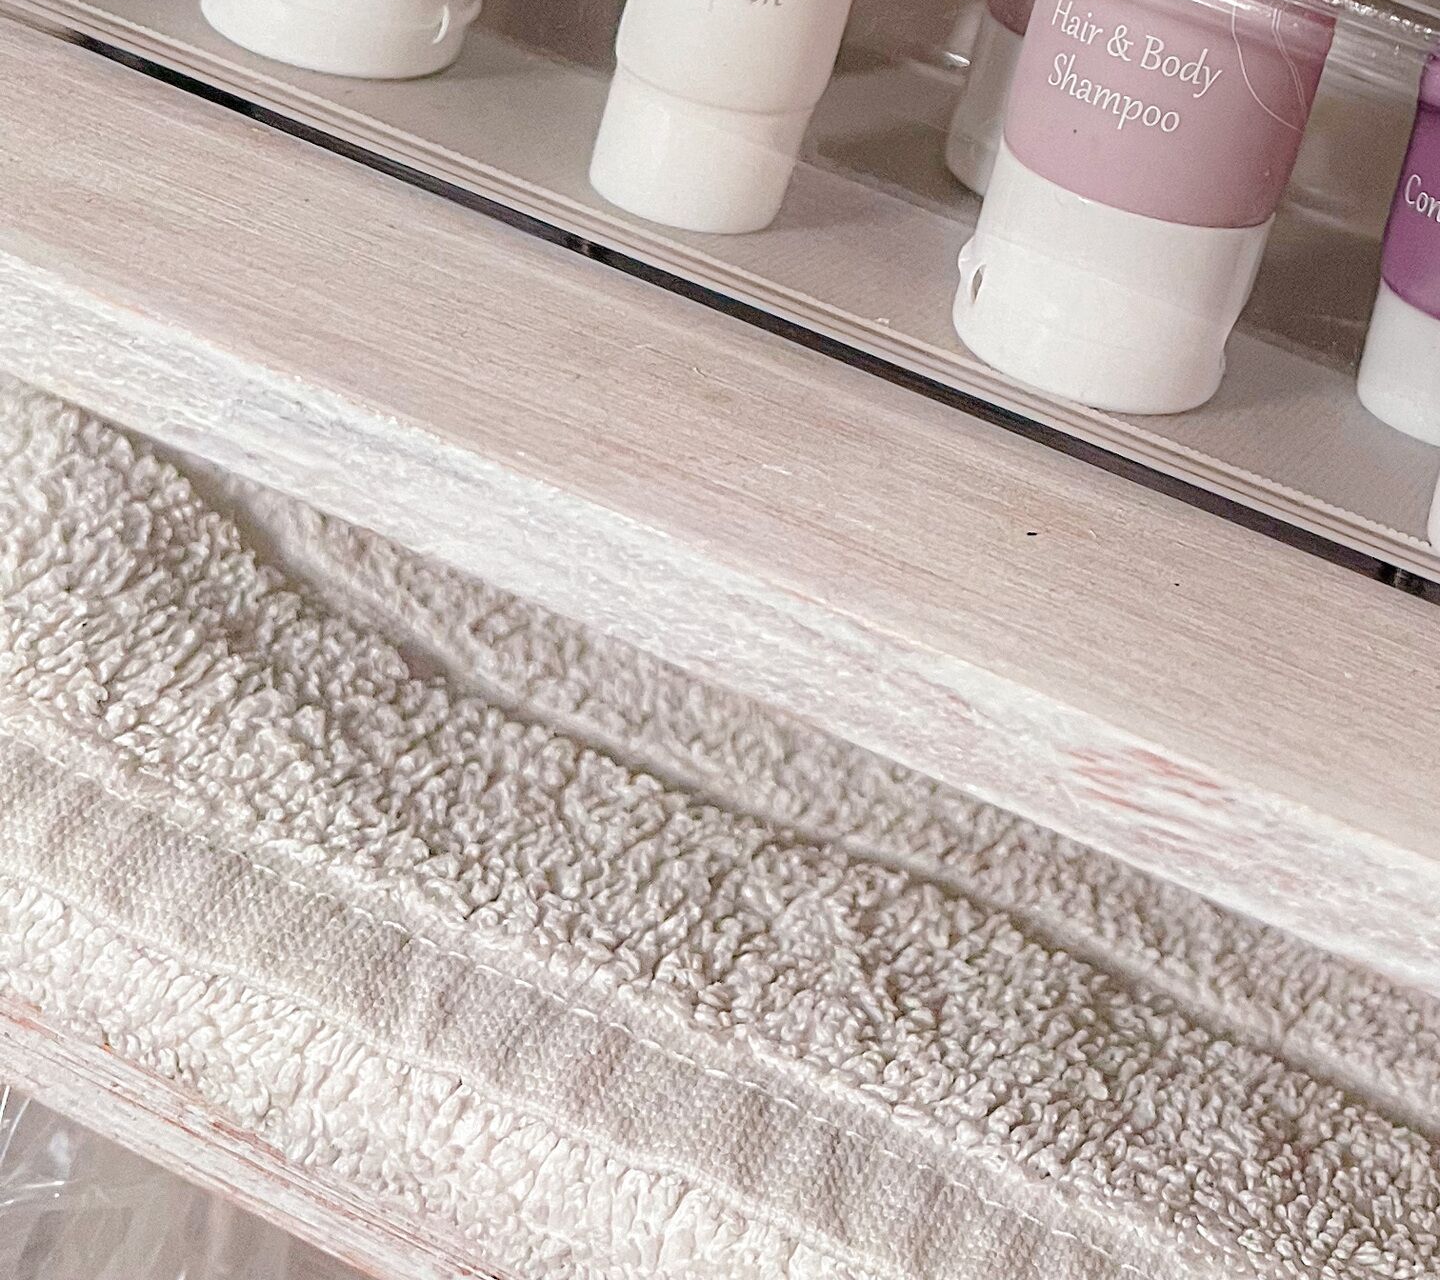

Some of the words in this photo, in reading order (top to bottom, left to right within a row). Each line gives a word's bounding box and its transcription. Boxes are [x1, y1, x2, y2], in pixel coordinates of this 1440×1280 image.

[1048, 52, 1181, 133] Shampoo
[1106, 24, 1134, 63] &
[1140, 34, 1223, 99] Body
